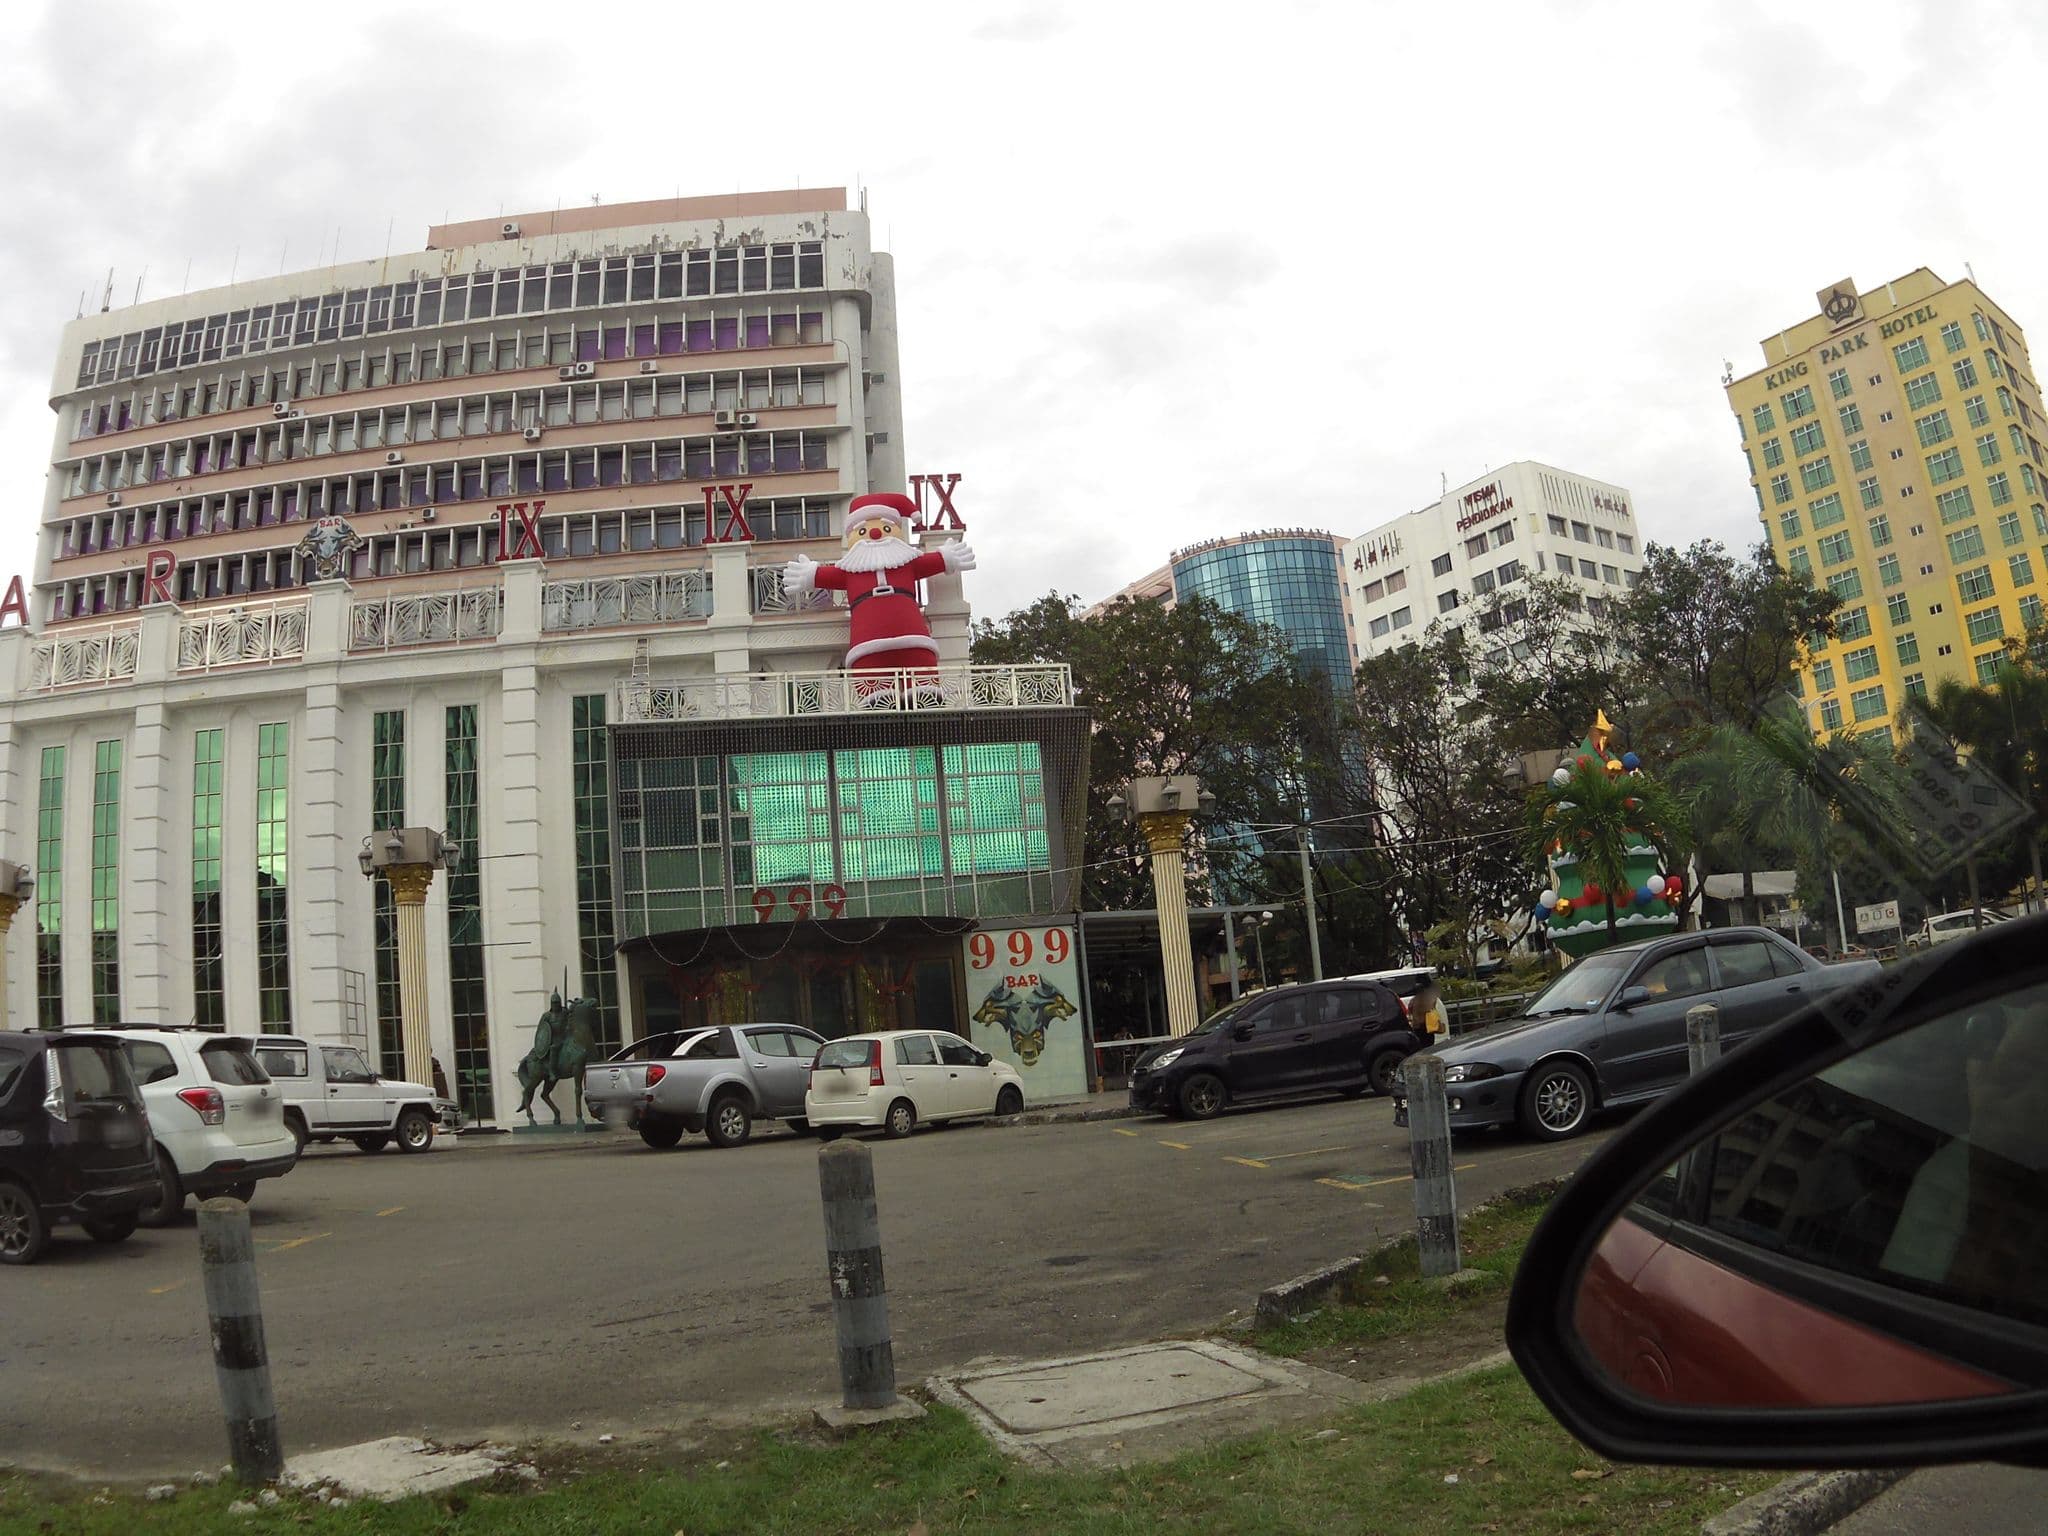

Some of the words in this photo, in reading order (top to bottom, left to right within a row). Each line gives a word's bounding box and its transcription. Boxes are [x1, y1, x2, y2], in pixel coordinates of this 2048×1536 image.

[1764, 361, 1808, 391] KING
[1819, 332, 1869, 365] PARK
[1879, 304, 1938, 340] HOTEL
[1463, 482, 1498, 506] WISMA
[319, 517, 343, 528] BAR
[494, 500, 546, 562] IX
[701, 483, 756, 544] IX
[909, 473, 967, 532] IX
[1456, 496, 1513, 533] PENDIDIKAN
[1180, 535, 1227, 556] WISMA
[1239, 527, 1334, 543] BANDARAYA
[969, 927, 1070, 970] 999
[1005, 974, 1040, 988] BAR
